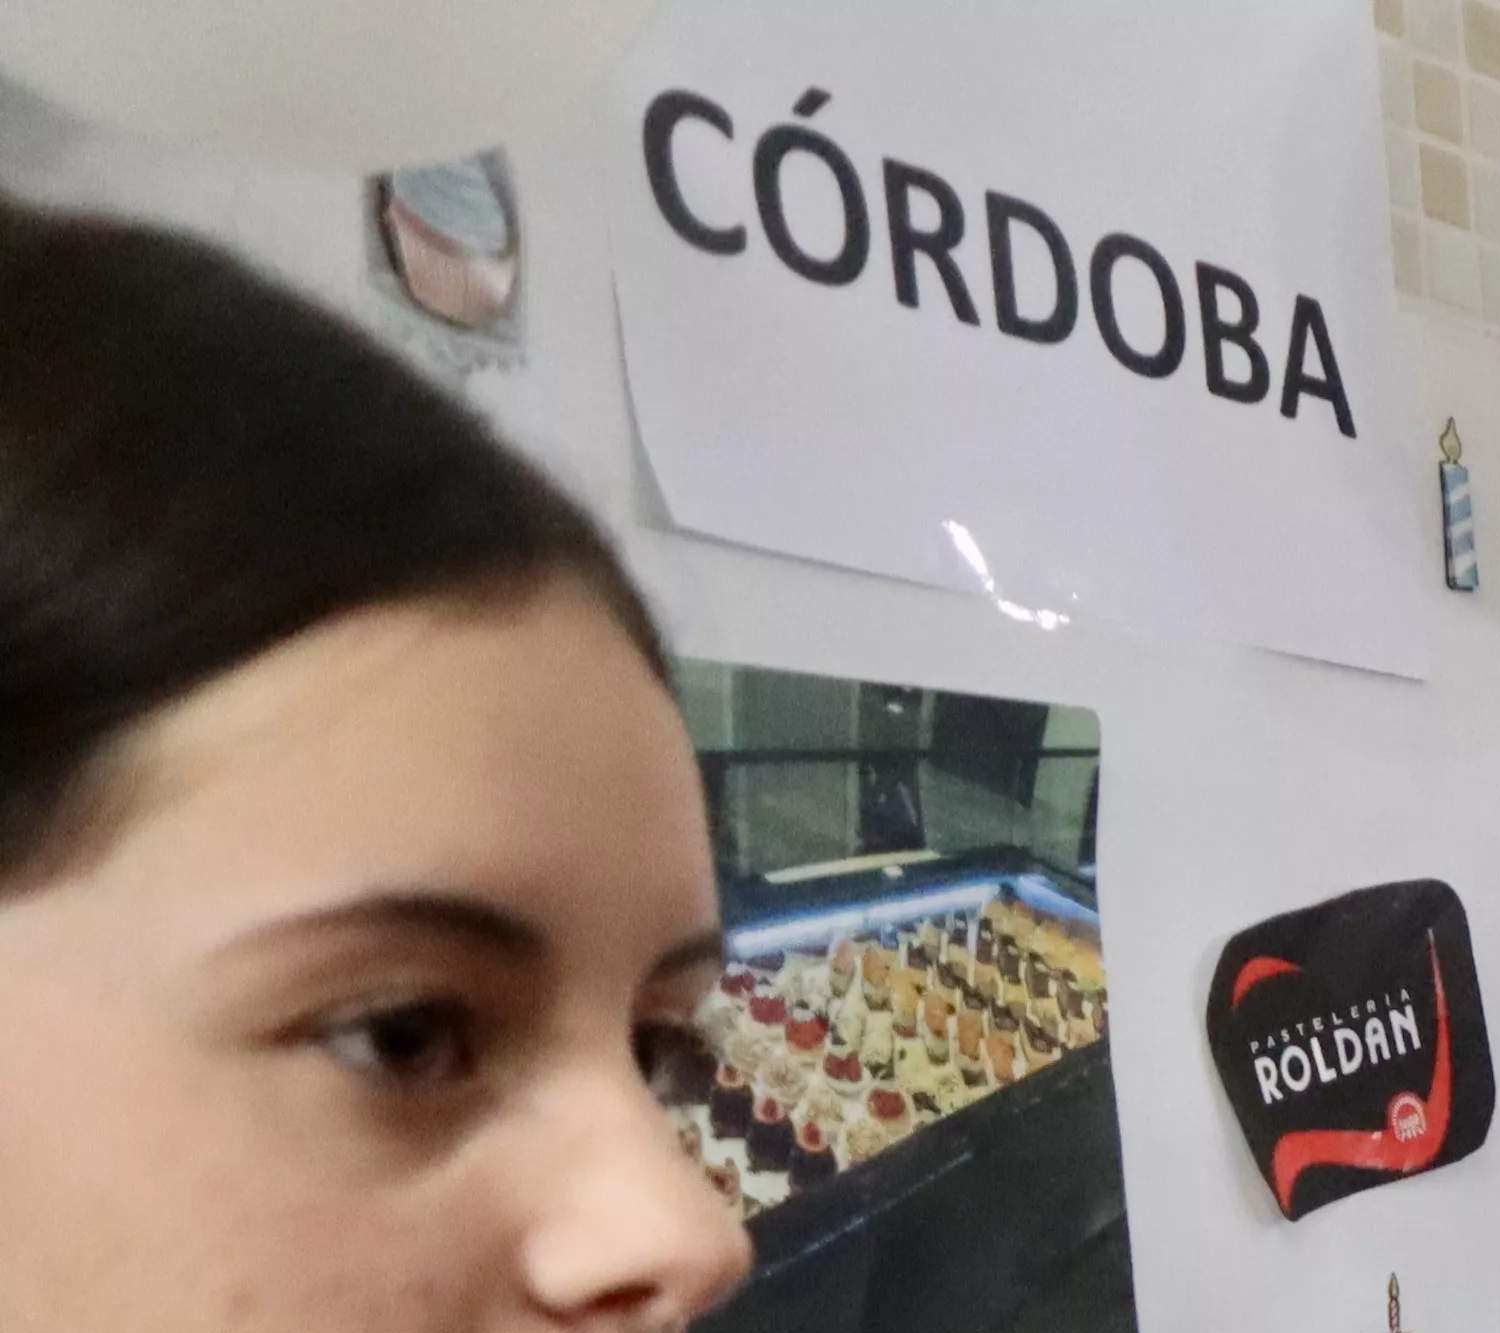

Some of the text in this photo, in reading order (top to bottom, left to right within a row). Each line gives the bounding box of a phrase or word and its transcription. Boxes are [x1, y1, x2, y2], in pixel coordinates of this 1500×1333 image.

[643, 86, 1357, 440] CÓRDOBA
[1250, 988, 1412, 1053] PASTELERIA
[1254, 1004, 1421, 1105] ROLDAN
